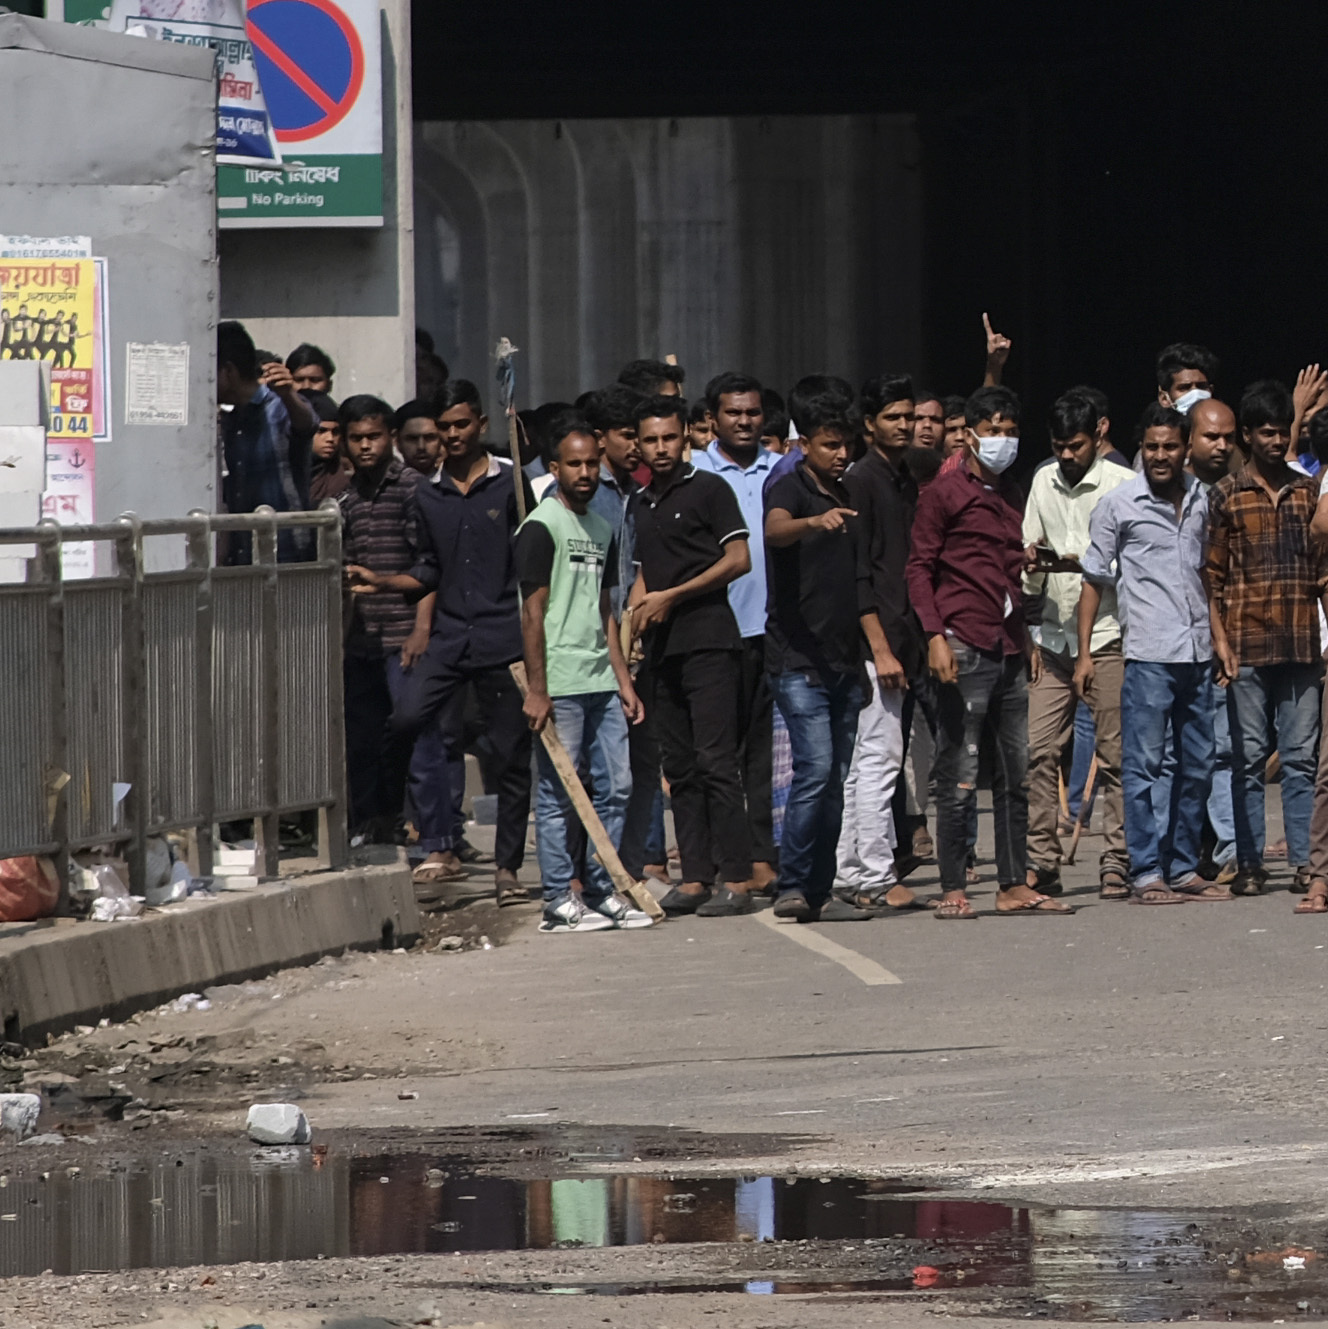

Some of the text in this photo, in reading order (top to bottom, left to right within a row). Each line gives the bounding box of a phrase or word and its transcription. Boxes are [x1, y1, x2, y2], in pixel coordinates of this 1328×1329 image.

[252, 193, 324, 207] No Parking
[68, 416, 88, 433] 44
